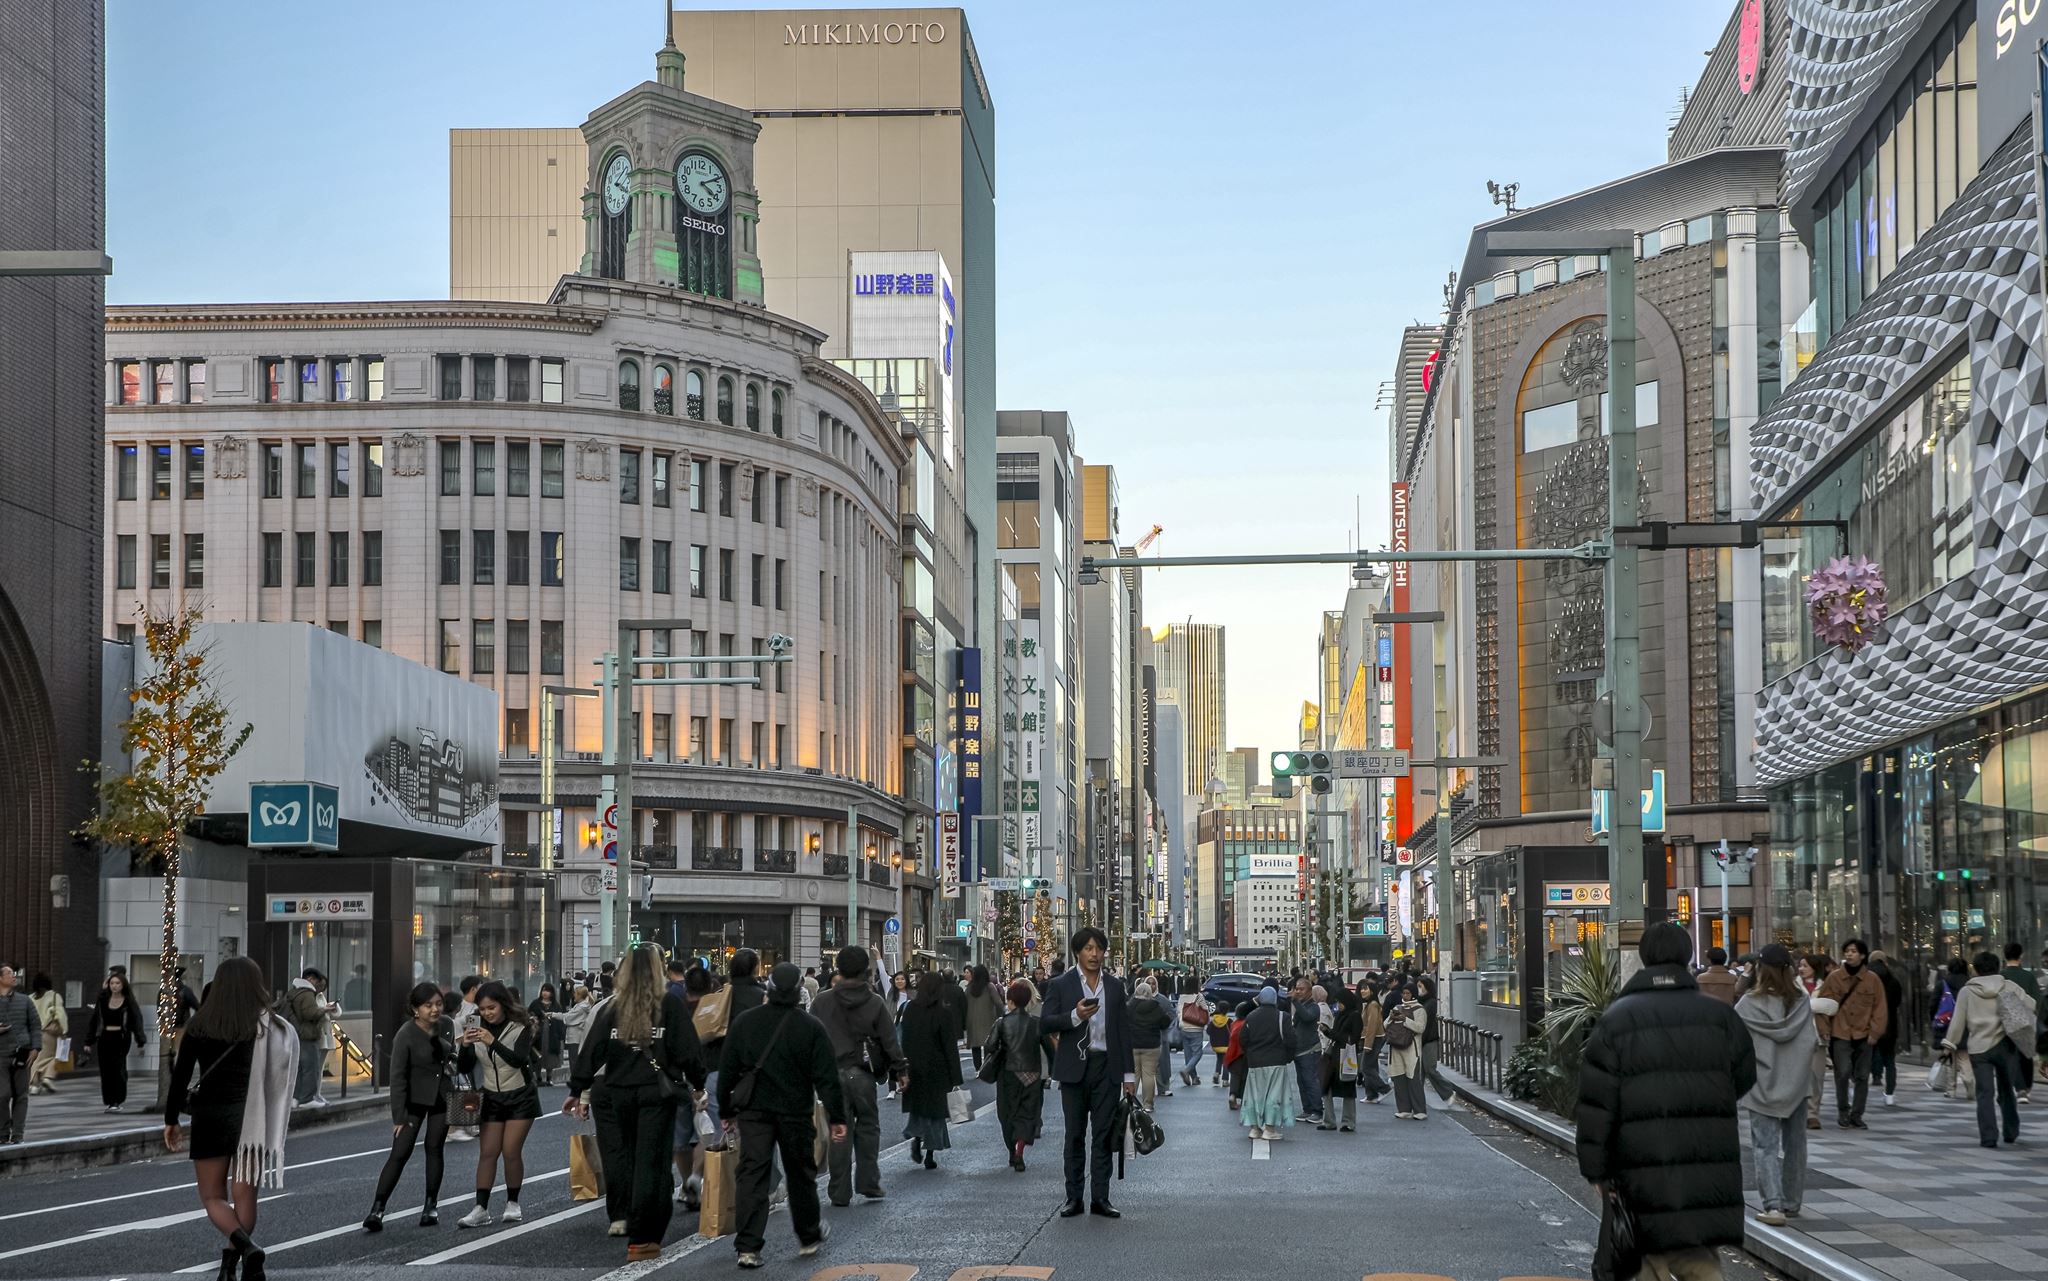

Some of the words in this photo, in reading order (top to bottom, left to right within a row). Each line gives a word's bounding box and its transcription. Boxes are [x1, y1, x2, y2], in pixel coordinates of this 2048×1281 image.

[784, 22, 945, 45] MIKIMOTO
[684, 165, 691, 175] 10
[681, 174, 688, 184] 9
[684, 185, 690, 194] 8
[716, 184, 723, 193] 3
[691, 193, 698, 203] 7
[698, 198, 705, 207] 6
[707, 198, 712, 207] 5
[682, 216, 725, 235] SEIKO
[856, 273, 933, 295] 山野楽器
[1862, 448, 1918, 504] NISSAN
[1021, 637, 1037, 732] 教文館
[965, 692, 979, 778] 山野楽器
[1345, 757, 1404, 767] 銀座四丁目
[1022, 785, 1038, 807] 本
[946, 835, 958, 893] キムラヤのパン
[1254, 859, 1292, 867] Brillia
